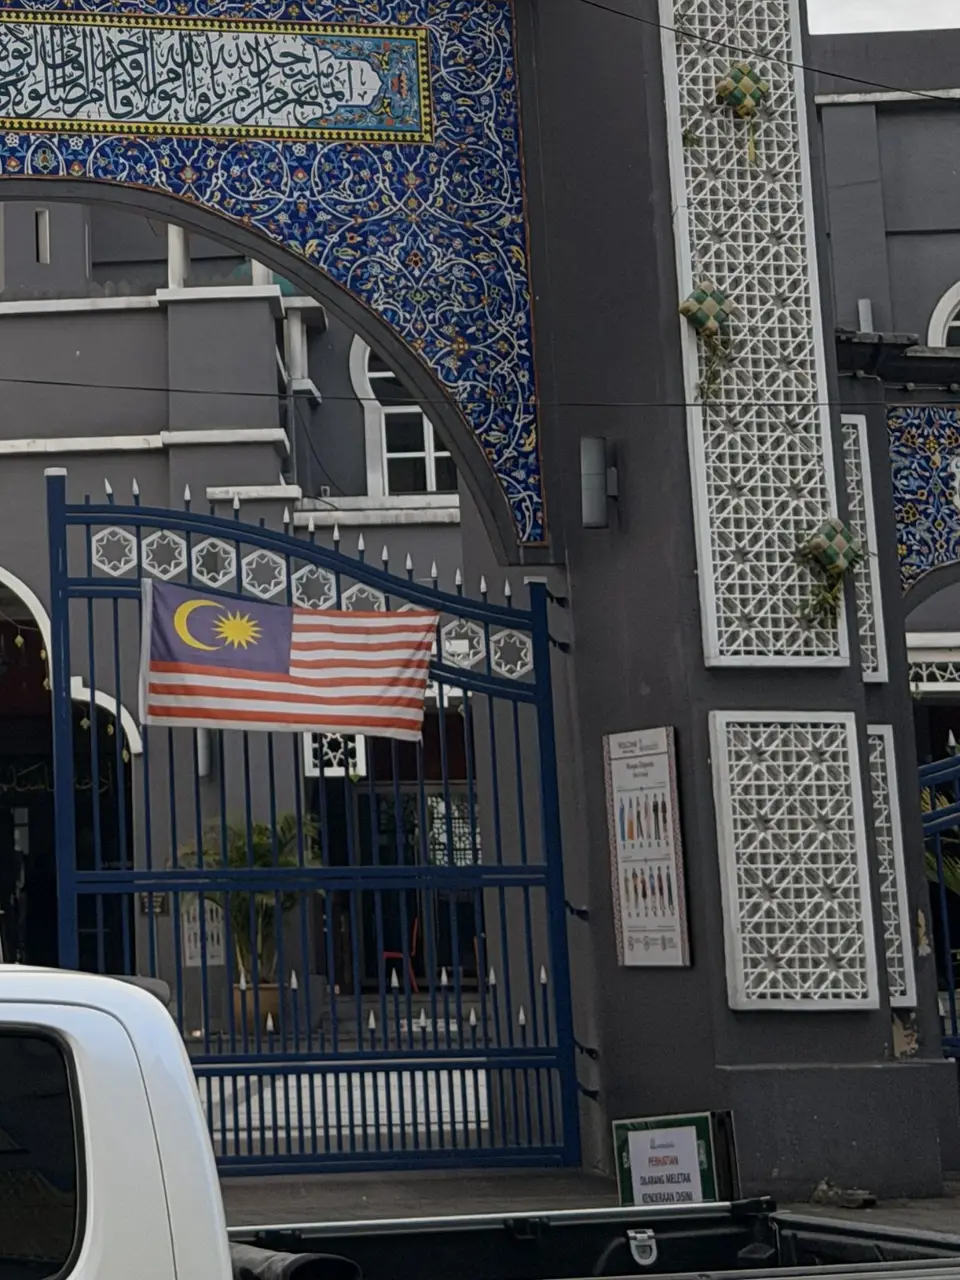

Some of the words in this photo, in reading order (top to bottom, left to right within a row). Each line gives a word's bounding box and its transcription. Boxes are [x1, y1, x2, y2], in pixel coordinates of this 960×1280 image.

[648, 1155, 679, 1167] PERHATIAN
[640, 1174, 665, 1186] DILARANG
[665, 1172, 691, 1184] MELETAK
[642, 1192, 675, 1203] KENDERAAN
[675, 1191, 693, 1201] DISINI
